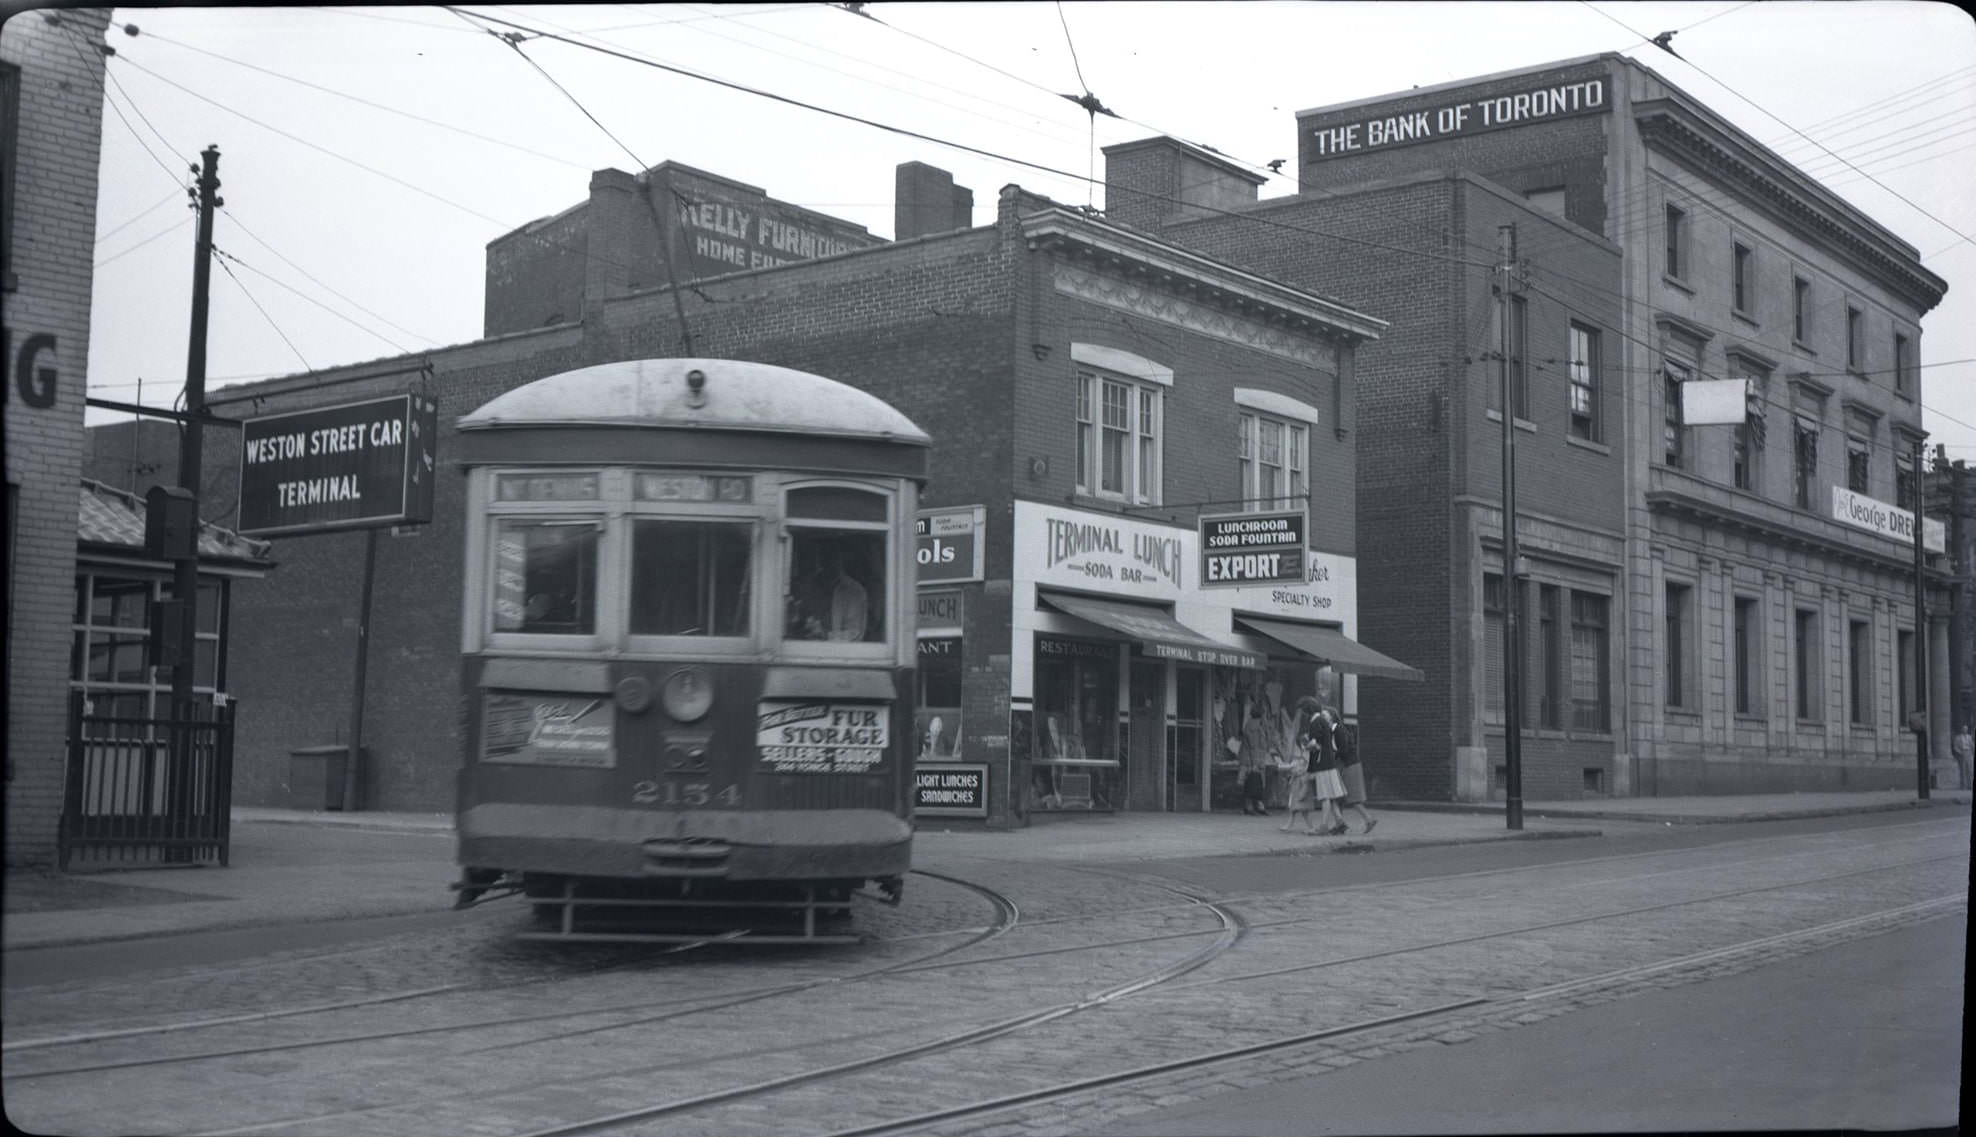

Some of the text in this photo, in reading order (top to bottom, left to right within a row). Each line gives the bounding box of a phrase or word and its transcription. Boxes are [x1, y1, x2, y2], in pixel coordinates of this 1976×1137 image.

[1315, 80, 1603, 155] THE BANK OF TORONTO
[681, 202, 853, 260] KELLY FURNITUR
[697, 236, 746, 267] HOME
[14, 332, 58, 409] G
[246, 419, 402, 465] WESTON STREET CAR
[277, 474, 361, 508] TERMINAL
[1849, 494, 1887, 531] George
[1209, 530, 1297, 546] SODA FOUNTAIN
[1217, 519, 1288, 534] LUNCHROOM
[917, 538, 956, 564] ols
[1046, 517, 1183, 590] TERMINAL LUNCH
[1083, 561, 1142, 584] SODA BAR
[1207, 553, 1281, 581] EXPORT
[1308, 558, 1330, 582] ker
[918, 598, 957, 620] UNCH
[1272, 589, 1332, 609] SPECIALTY SHOP
[918, 640, 953, 655] ANT
[1156, 643, 1193, 661] TERMINAL
[1197, 650, 1217, 664] STOP
[1241, 655, 1256, 669] BAR
[831, 709, 878, 727] FUR
[781, 726, 884, 745] STORAGE
[632, 779, 743, 806] 2154
[916, 774, 978, 788] LIGHT LUNCHES
[920, 789, 974, 803] SANDWICHES
